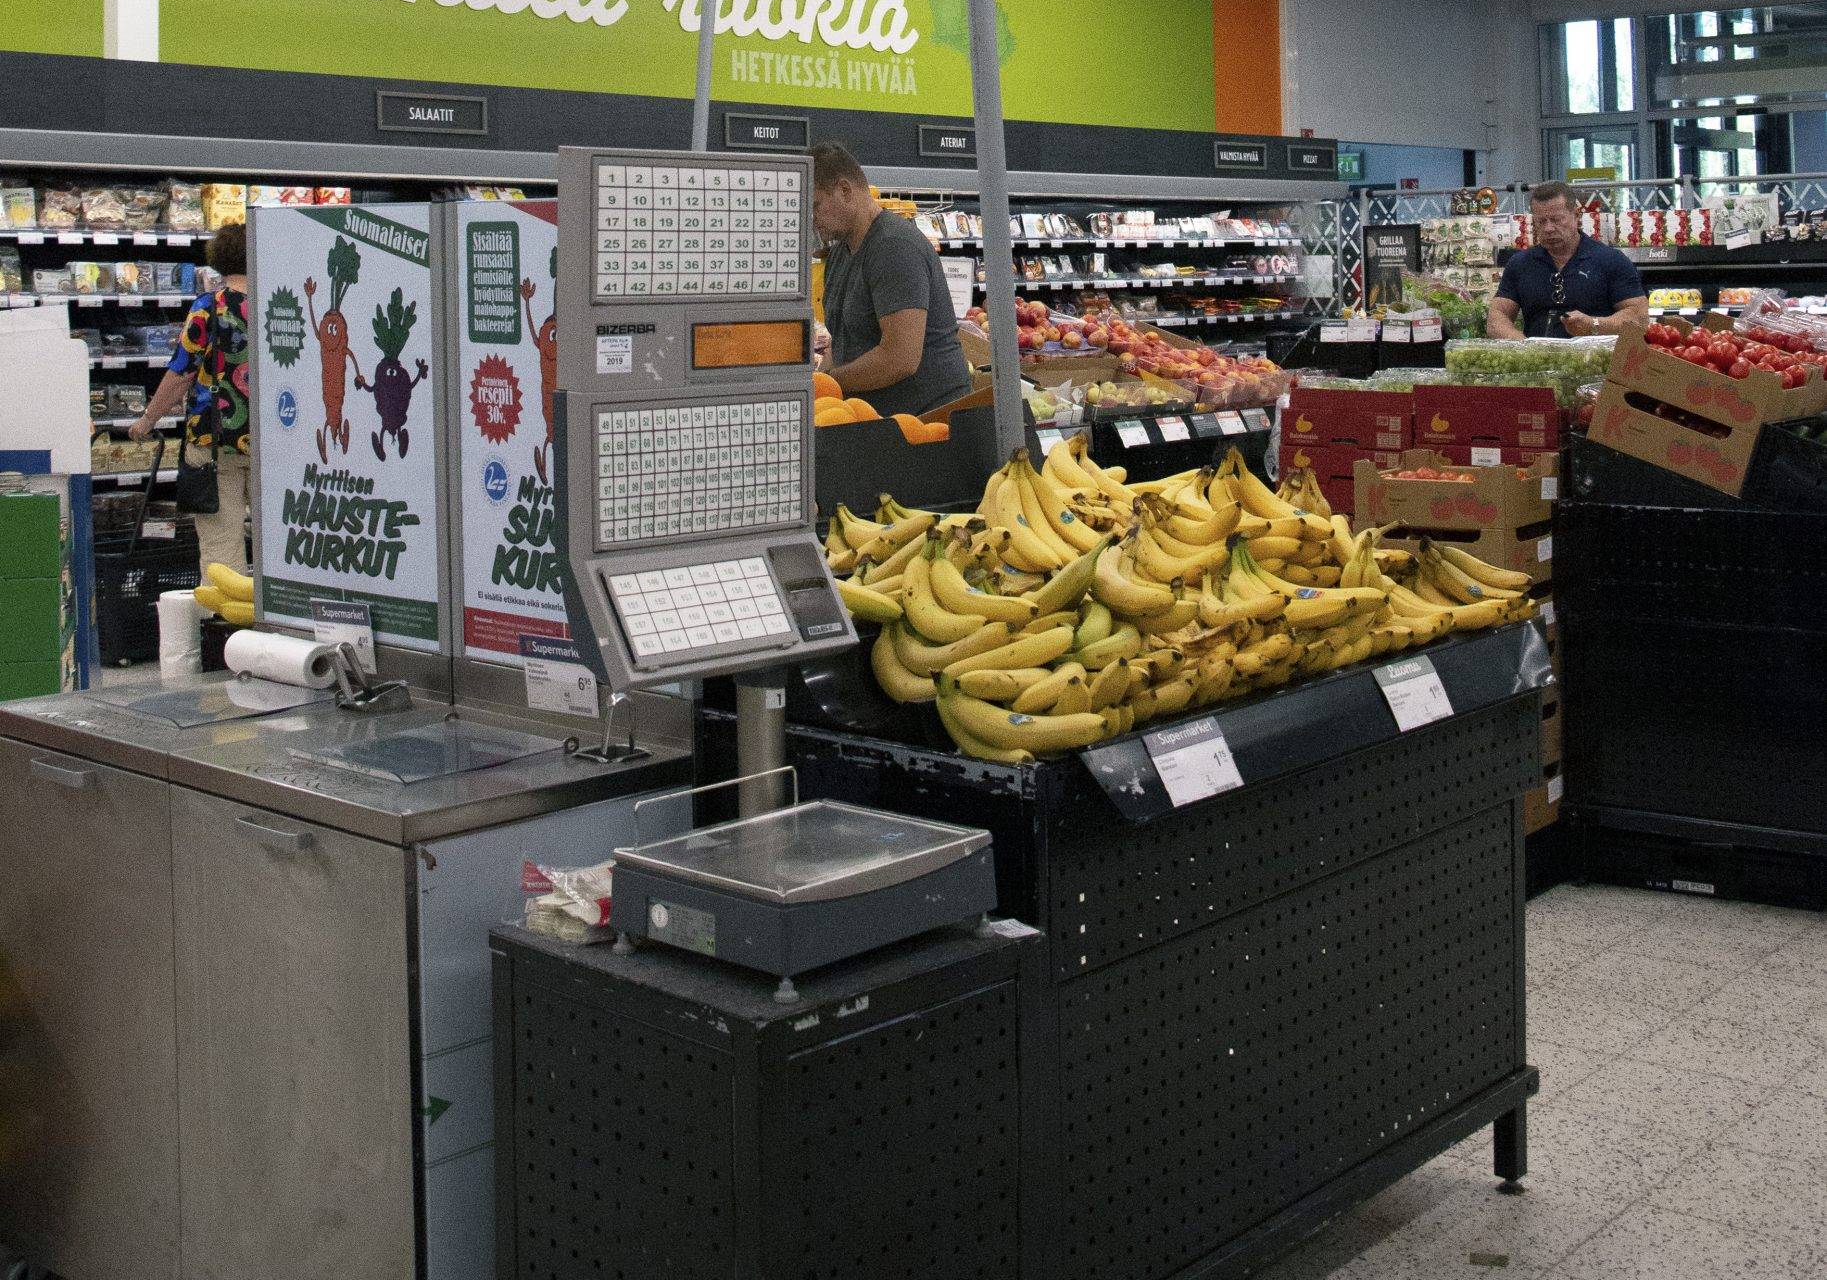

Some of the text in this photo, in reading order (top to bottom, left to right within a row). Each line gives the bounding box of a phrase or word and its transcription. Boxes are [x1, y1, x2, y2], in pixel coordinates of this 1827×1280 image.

[731, 50, 917, 95] HETKESSÄ HYVÄÄ
[409, 106, 454, 122] SALAATIT
[753, 126, 780, 139] KEITOT
[940, 136, 966, 148] ATERIAT
[608, 174, 794, 187] 1 2 3 4 5 6 7 8
[607, 196, 797, 208] 9 10 11 12 13 14 15 16
[605, 217, 797, 228] 17 18 19 20 21 22 23 24
[344, 208, 429, 260] Suomalaiset
[473, 230, 513, 252] Sisältää
[1379, 235, 1404, 246] GRILLAA
[603, 238, 797, 249] 25 26 27 28 29 30 31 32
[1376, 246, 1407, 257] TUOREENA
[473, 251, 513, 268] runsaasti
[603, 259, 796, 270] 33 34 35 36 37 38 39 40
[602, 282, 617, 292] 41
[630, 282, 646, 291] 42
[656, 281, 672, 291] 43
[682, 281, 698, 290] 44
[708, 280, 723, 290] 45
[733, 280, 748, 289] 46
[757, 279, 772, 289] 47
[596, 324, 656, 336] BIZERBA
[606, 357, 623, 365] 2019
[478, 385, 513, 409] resepti
[302, 462, 375, 495] Myrttisen
[517, 475, 553, 509] Myr
[282, 488, 421, 539] MAUSTE-
[503, 504, 556, 548] SU
[284, 527, 407, 581] KURKUT
[491, 543, 563, 595] KUR
[477, 590, 484, 599] Ei
[484, 591, 502, 602] sisällä
[503, 595, 526, 607] etikkaa
[526, 598, 540, 608] eikä
[321, 606, 365, 621] Supermarket
[776, 693, 781, 706] 1
[1157, 720, 1214, 746] Supermarket
